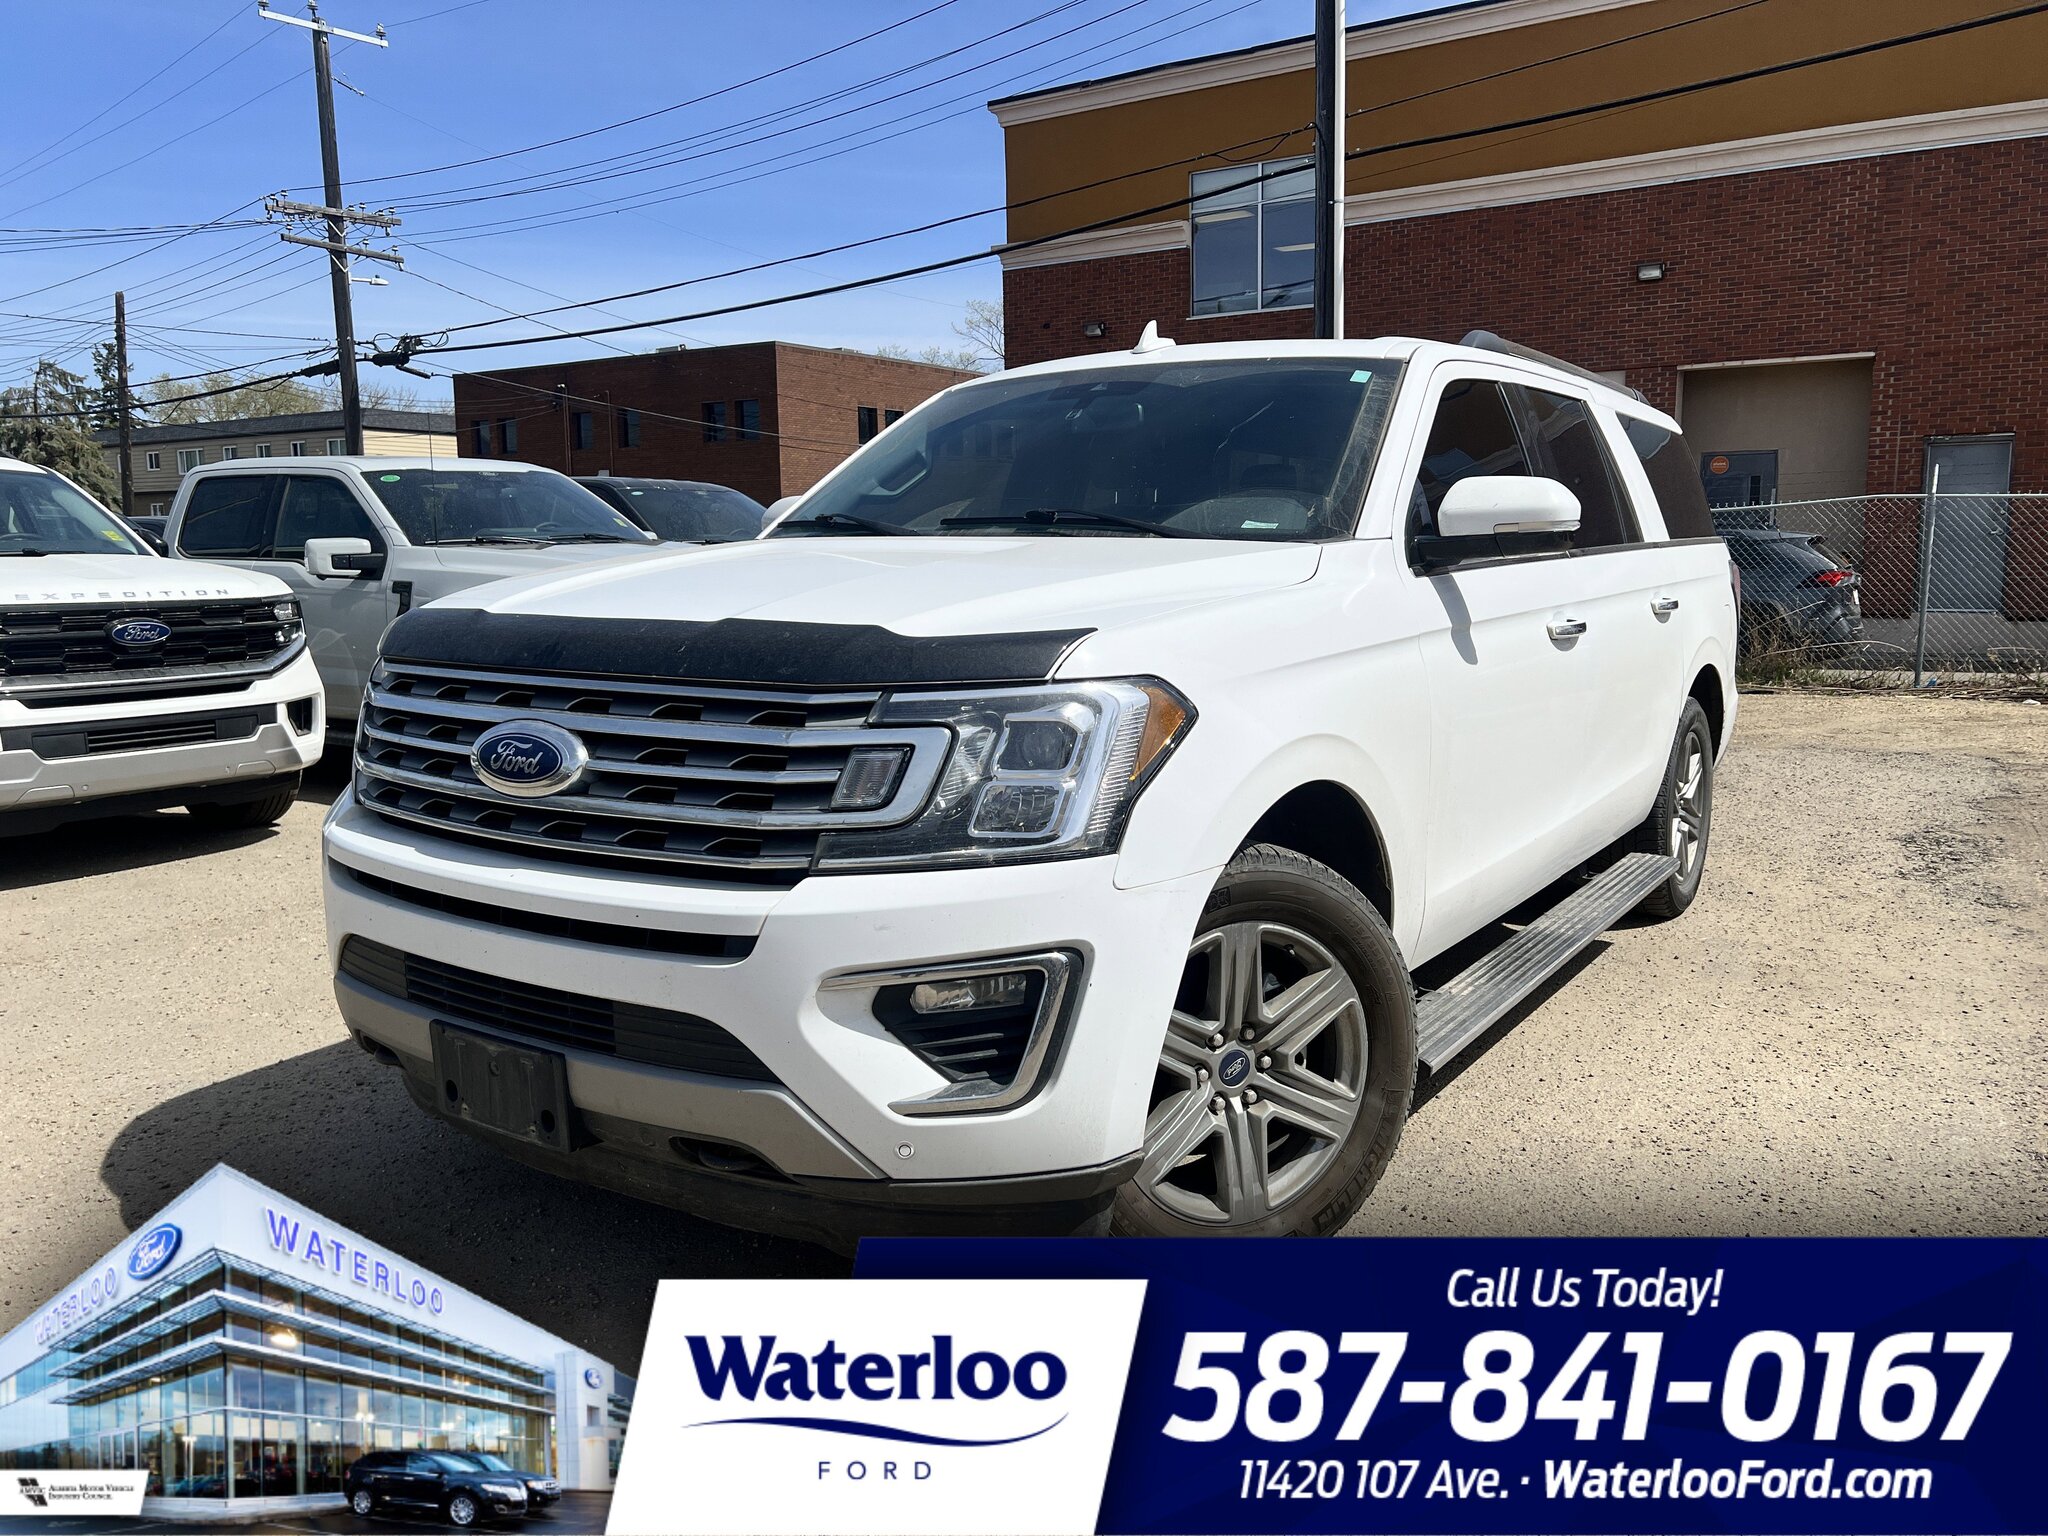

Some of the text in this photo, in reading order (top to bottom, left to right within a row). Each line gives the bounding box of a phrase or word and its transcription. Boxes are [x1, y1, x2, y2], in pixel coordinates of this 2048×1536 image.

[14, 588, 230, 601] EXPEDITION
[122, 622, 161, 641] Ford
[490, 739, 544, 775] Ford
